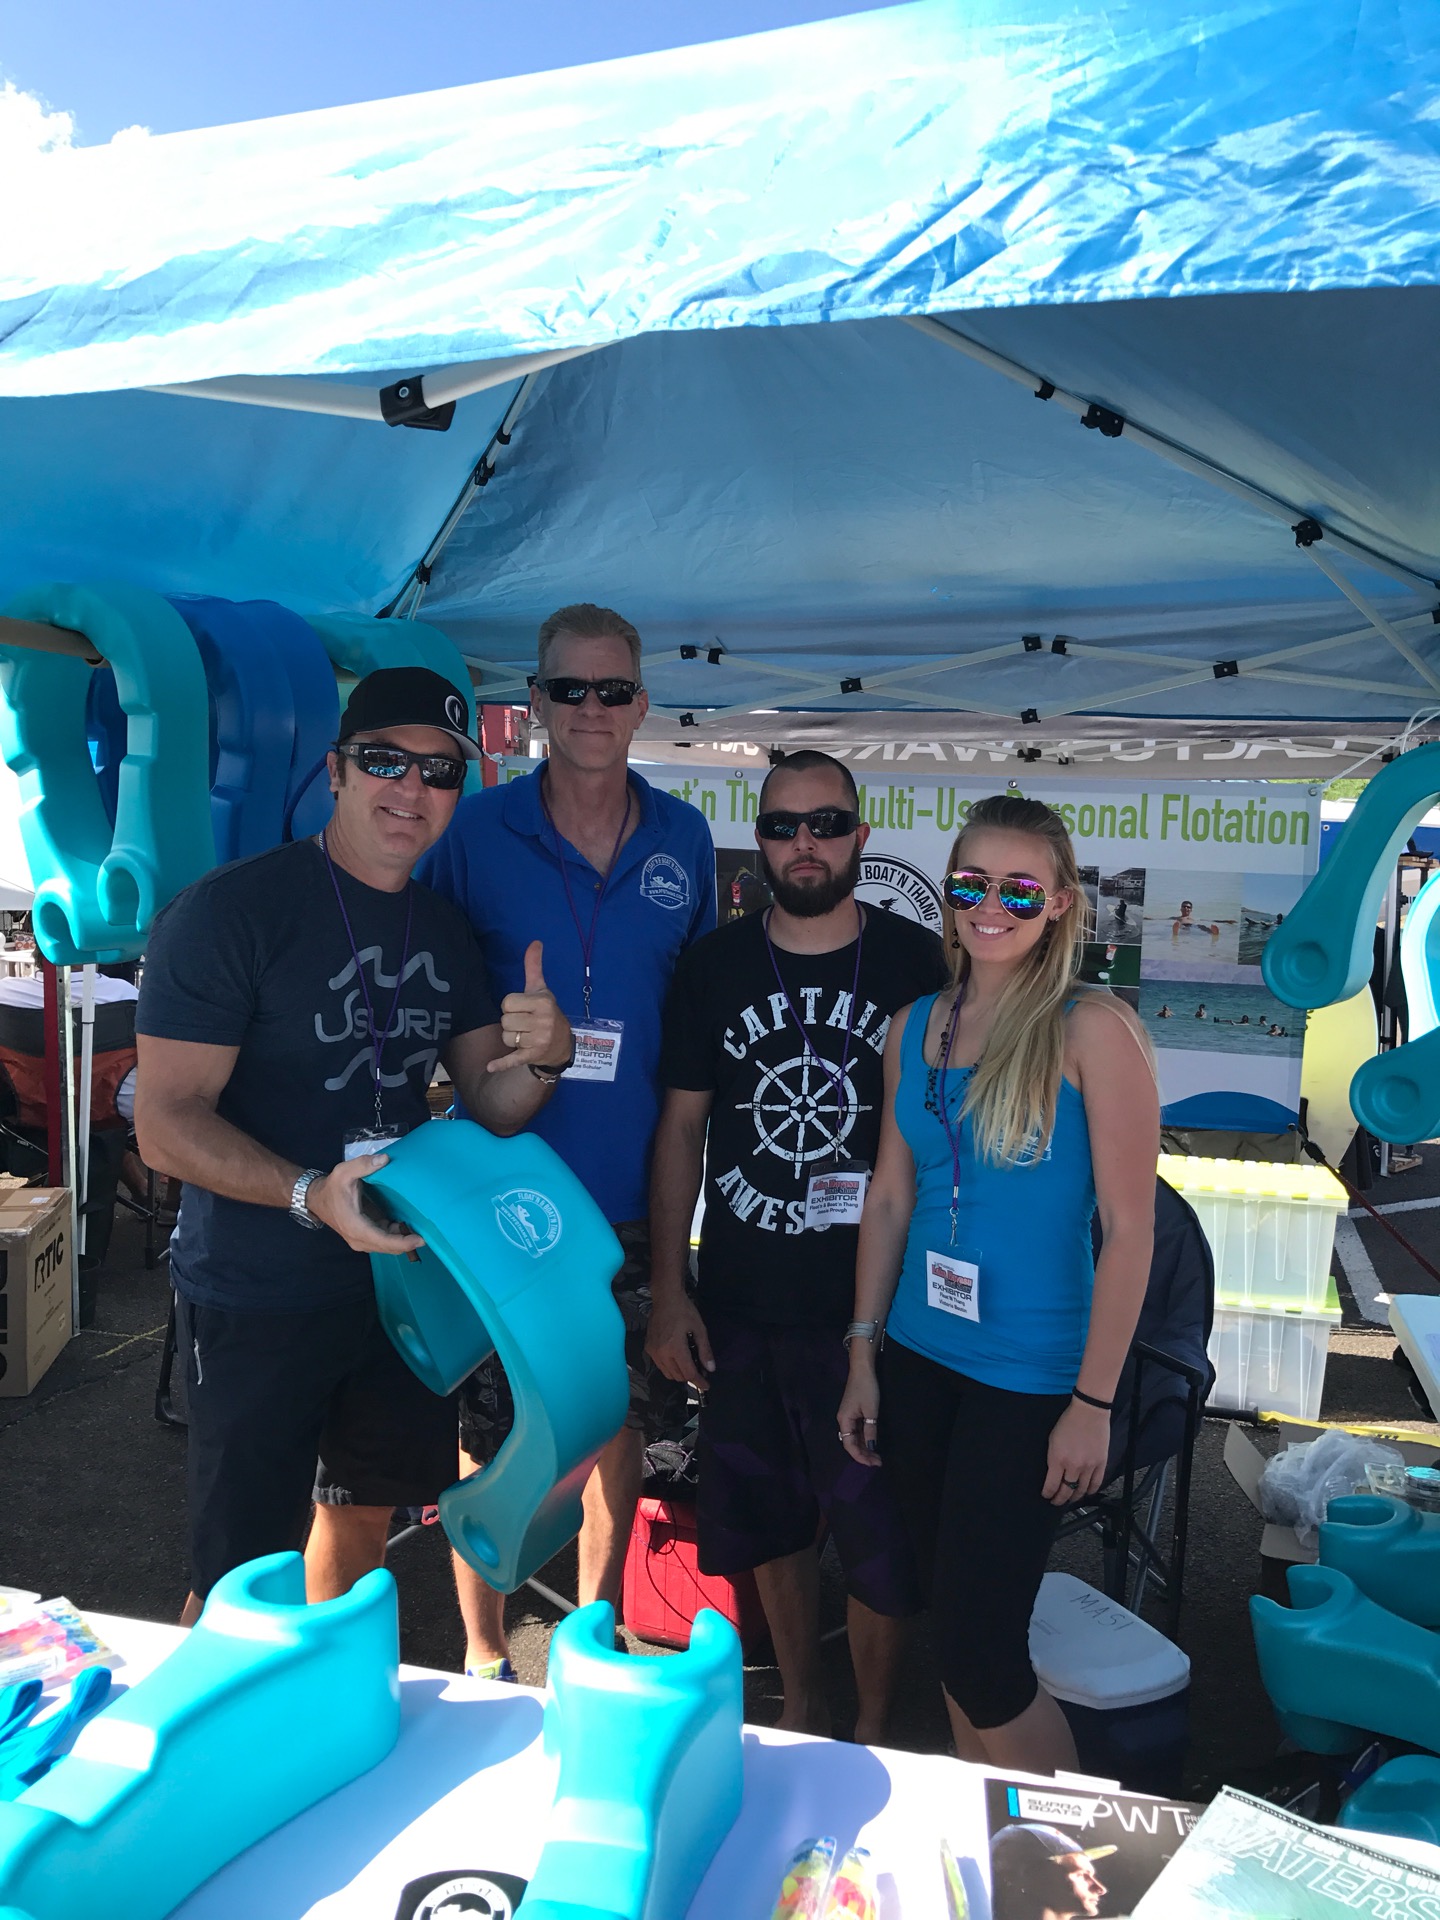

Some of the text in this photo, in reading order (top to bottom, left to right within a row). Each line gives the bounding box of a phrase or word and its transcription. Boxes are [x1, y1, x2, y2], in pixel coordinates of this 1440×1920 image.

[1160, 793, 1310, 845] Flotation
[864, 864, 909, 889] BOAT'N
[906, 880, 938, 921] THANG
[811, 1195, 857, 1204] EXHIBITOR
[34, 1231, 65, 1293] RTIC
[932, 1281, 972, 1302] EXHIBITOR
[1027, 1798, 1082, 1812] SUPRA
[1027, 1804, 1083, 1818] BOATS
[1080, 1795, 1190, 1837] PWT
